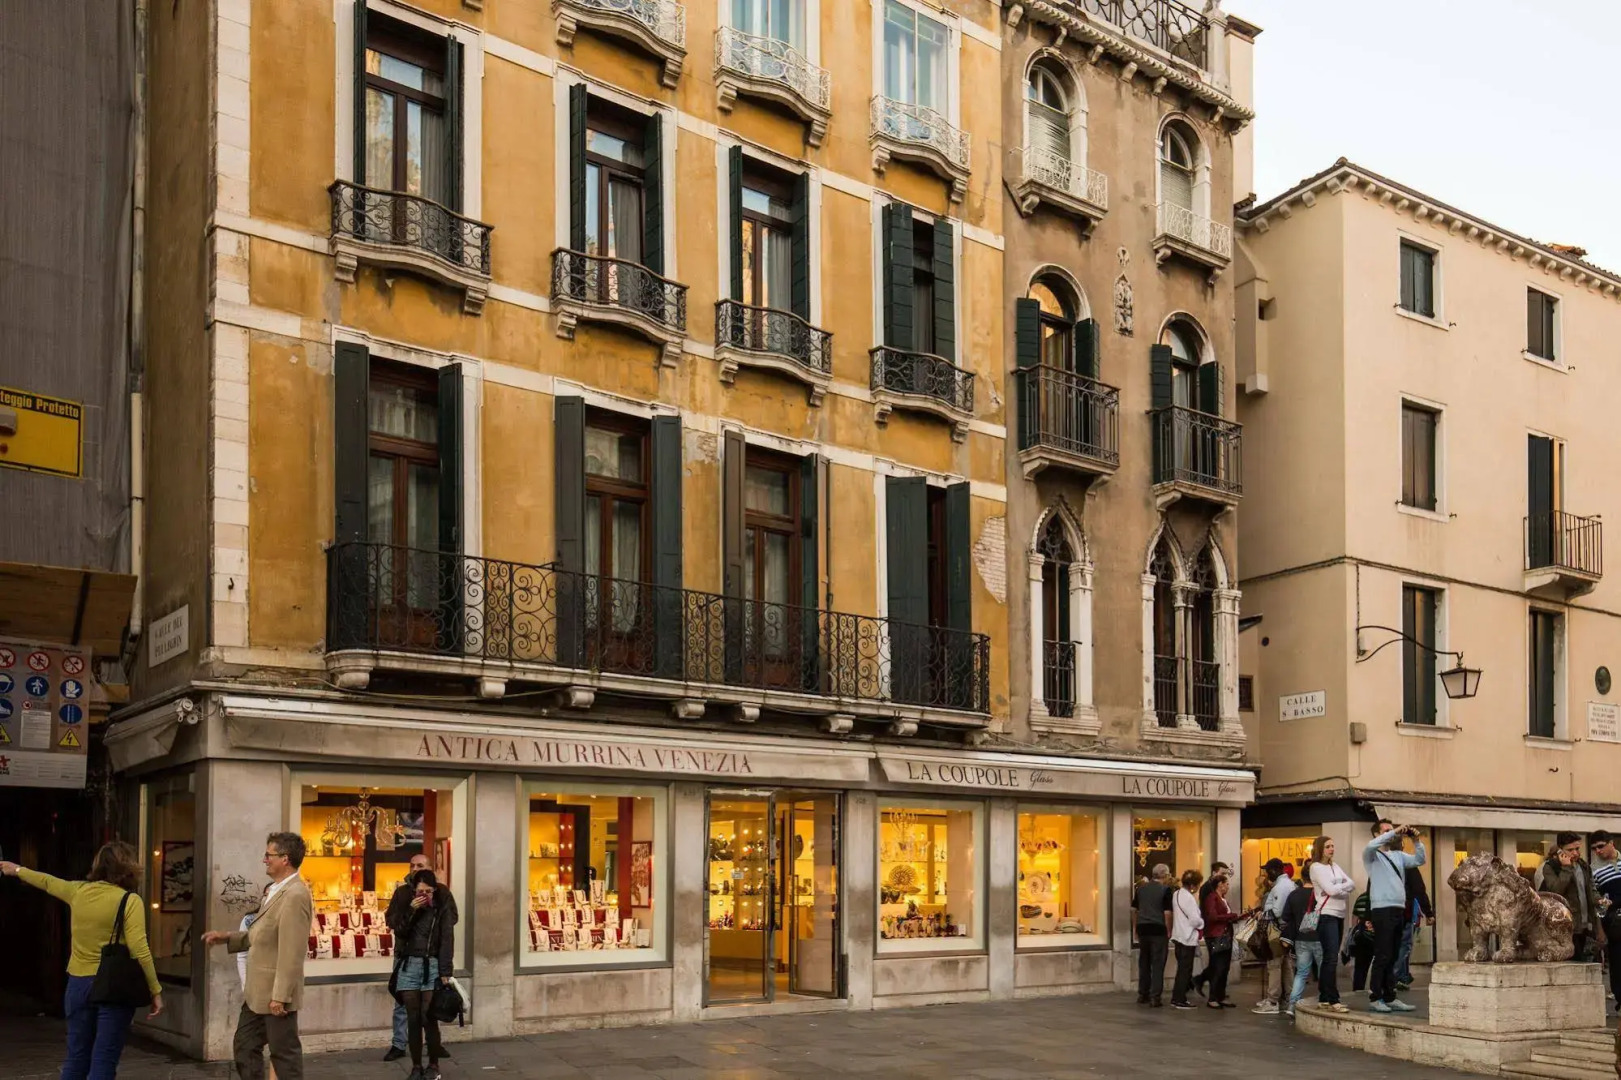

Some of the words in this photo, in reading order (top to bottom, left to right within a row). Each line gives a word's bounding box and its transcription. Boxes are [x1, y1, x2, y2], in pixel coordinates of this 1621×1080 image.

[36, 398, 79, 417] Protetto
[1287, 695, 1316, 706] CALLE
[1294, 706, 1323, 716] BASSO
[417, 735, 520, 762] ANTICA
[533, 741, 647, 768] MURRINA
[655, 749, 753, 774] VENEZIA
[907, 761, 933, 781] LA
[938, 764, 1020, 787] COUPOLE
[1029, 769, 1054, 790] Glass
[1122, 776, 1142, 795] LA
[1146, 778, 1210, 798] COUPOLE
[1217, 781, 1237, 796] Glass
